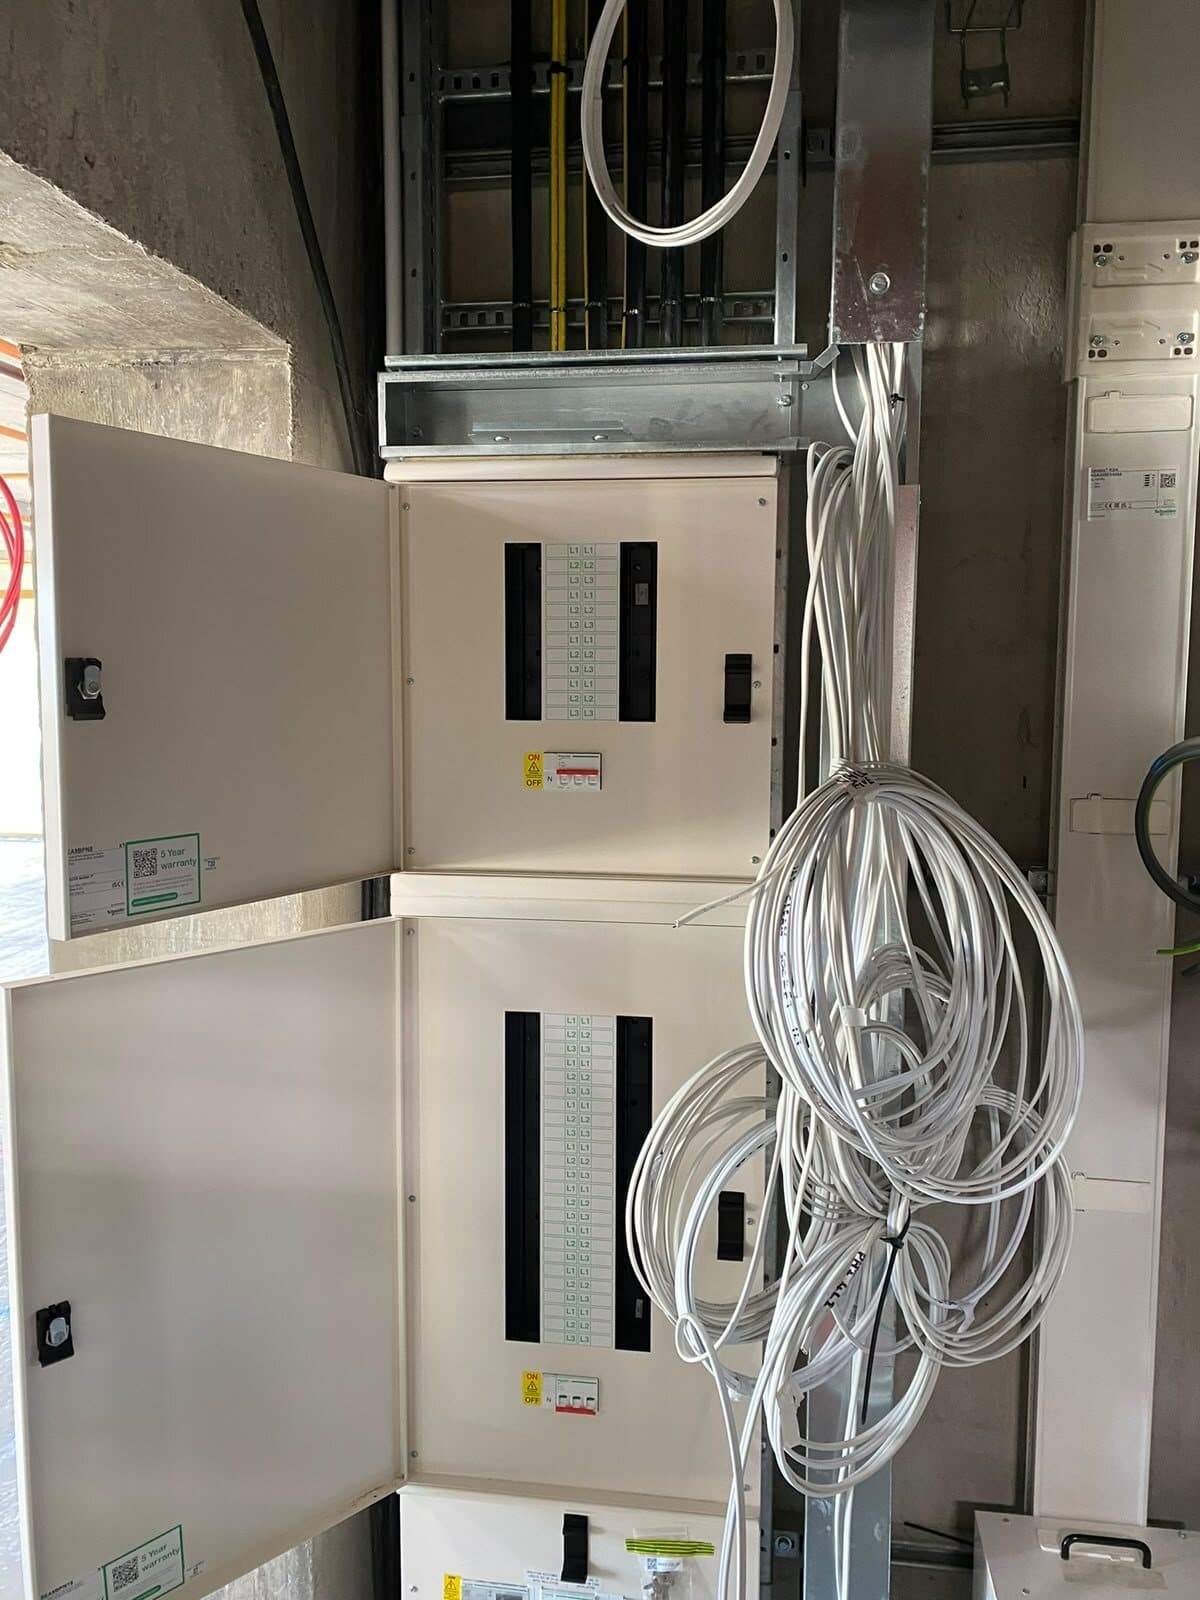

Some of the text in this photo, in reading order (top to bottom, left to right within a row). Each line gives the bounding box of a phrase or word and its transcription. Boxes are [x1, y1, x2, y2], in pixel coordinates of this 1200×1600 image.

[570, 546, 578, 554] L1
[570, 576, 580, 584] L3
[570, 592, 578, 600] L1
[570, 606, 580, 614] L2
[570, 650, 594, 658] L2 L2
[570, 680, 578, 688] L1
[526, 779, 542, 787] OFF
[160, 848, 185, 858] 5 Year
[160, 858, 197, 870] warranty
[566, 1016, 576, 1024] L1
[566, 1072, 590, 1082] L2 L2
[580, 1088, 590, 1096] L3
[580, 1102, 590, 1110] L1
[580, 1144, 590, 1152] L1
[580, 1158, 590, 1166] L2
[580, 1240, 590, 1248] L2
[140, 1544, 168, 1562] 5 Year
[141, 1548, 180, 1572] warranty
